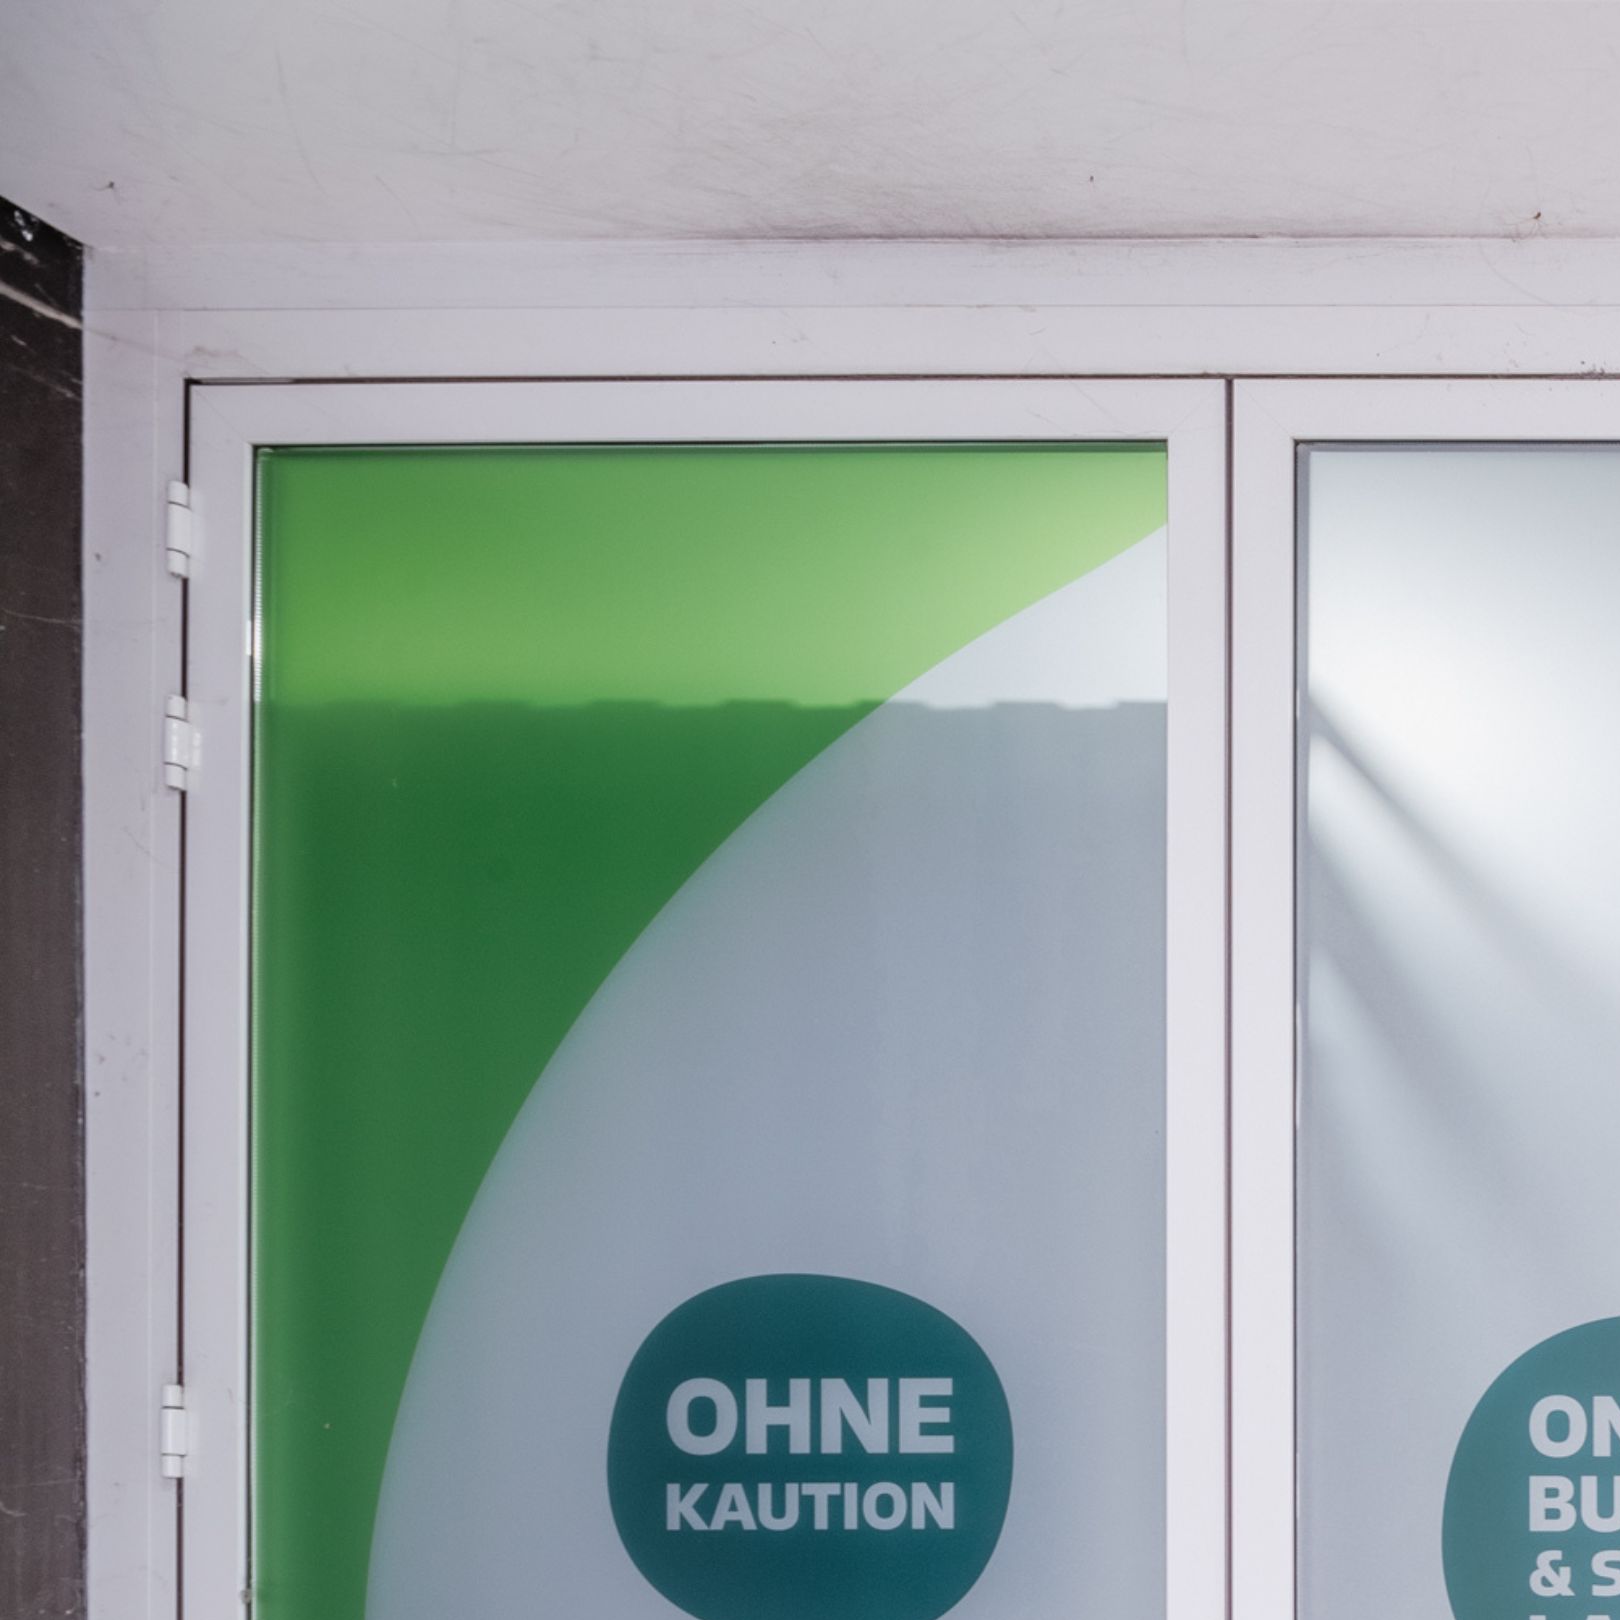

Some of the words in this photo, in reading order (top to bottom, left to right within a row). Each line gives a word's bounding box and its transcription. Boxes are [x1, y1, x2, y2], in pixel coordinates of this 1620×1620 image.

[665, 1377, 956, 1457] OHNE
[665, 1481, 956, 1532] KAUTION
[1528, 1548, 1575, 1598] &
